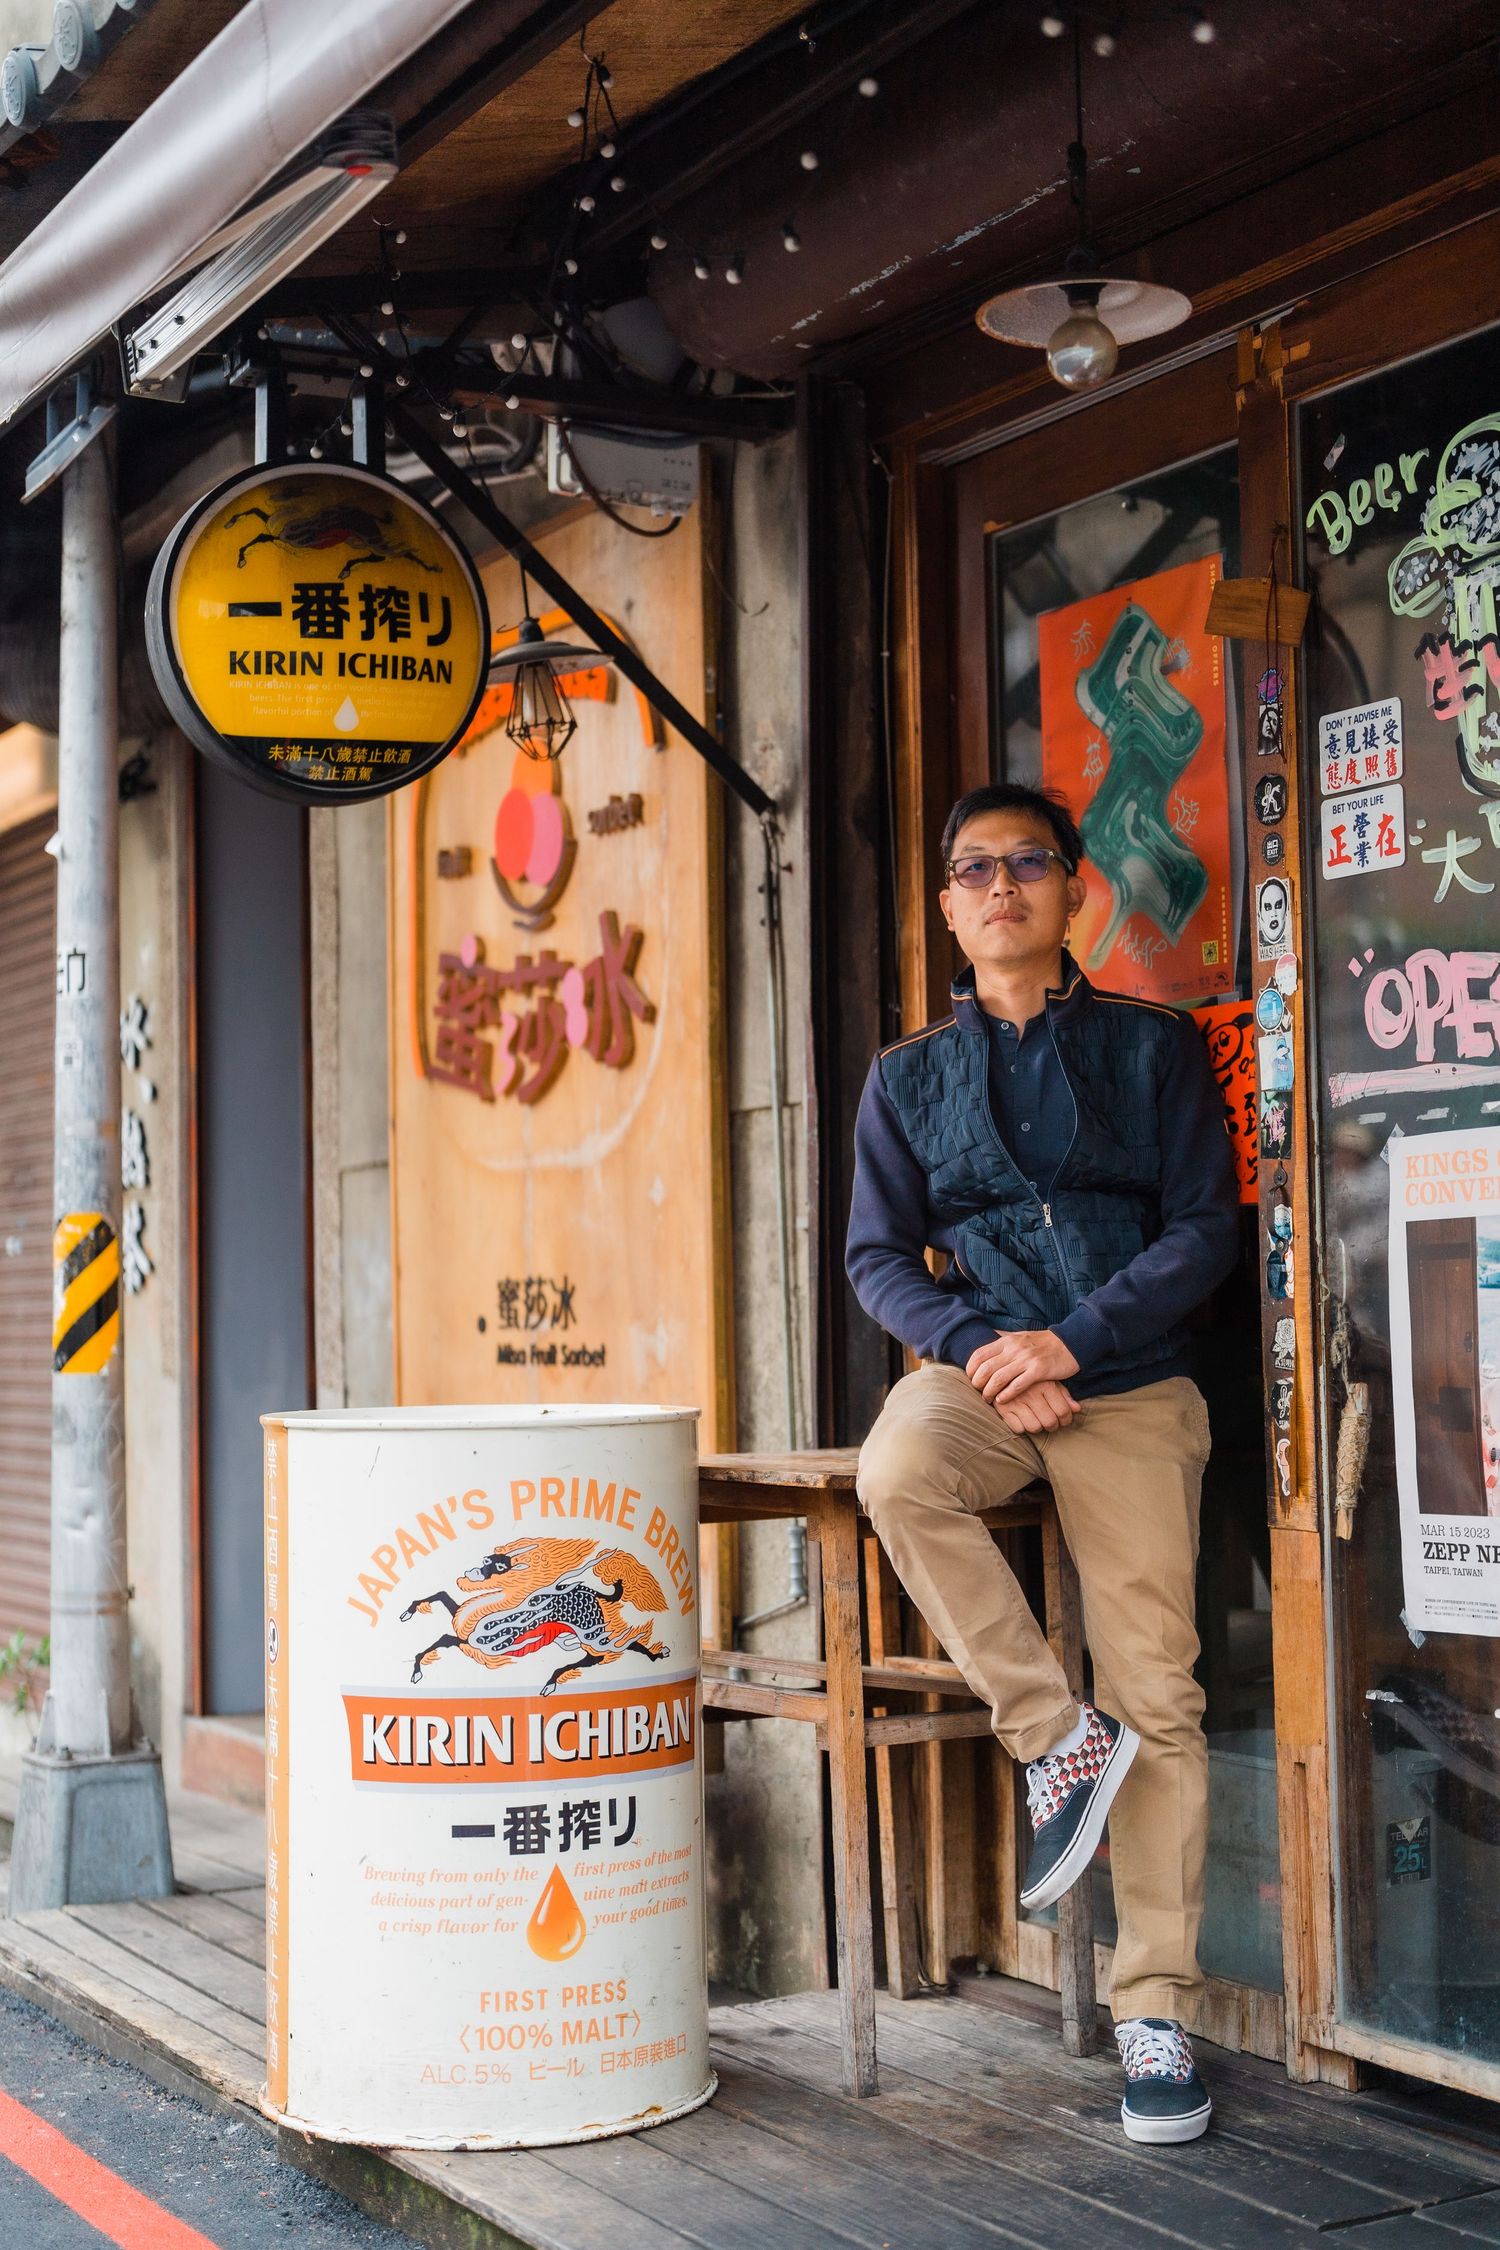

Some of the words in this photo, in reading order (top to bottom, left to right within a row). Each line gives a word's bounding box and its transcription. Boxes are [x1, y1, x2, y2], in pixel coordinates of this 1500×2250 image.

[1306, 448, 1430, 555] Beer
[228, 582, 452, 647] 一番搾り
[229, 651, 323, 677] KIRIN
[338, 652, 453, 685] ICHIBAN
[1354, 709, 1379, 725] ADVISE
[1381, 705, 1393, 717] ME
[268, 744, 412, 765] 未滿十八歲禁止飲酒
[1324, 718, 1400, 760] 意見接受
[308, 765, 374, 782] 禁止酒駕
[1325, 747, 1398, 790] 態度照舊
[1332, 802, 1345, 815] BET
[1347, 799, 1368, 811] YOUR
[1370, 794, 1384, 806] LIFE
[1267, 848, 1279, 856] EXIT
[1406, 1147, 1489, 1179] KINGS
[1420, 1523, 1446, 1537] MAR
[1449, 1526, 1461, 1538] 15
[1463, 1527, 1490, 1539] 2023
[348, 1488, 495, 1628] JAPAN'S
[510, 1477, 641, 1531] PRIME
[643, 1505, 696, 1616] BREW
[1422, 1541, 1471, 1562] ZEPP
[1423, 1565, 1452, 1576] TAIPEI,
[1453, 1567, 1484, 1578] TAIWAN
[362, 1713, 514, 1766] KIRIN
[528, 1696, 692, 1764] ICHIBAN
[451, 1795, 637, 1856] 一番搾り
[364, 1865, 425, 1886] Brewing
[429, 1868, 468, 1884] from
[473, 1868, 509, 1886] only
[513, 1866, 539, 1881] the
[573, 1861, 604, 1877] first
[608, 1858, 642, 1877] press
[644, 1851, 657, 1867] of
[657, 1850, 672, 1865] the
[674, 1844, 692, 1860] most
[371, 1892, 436, 1909] delicious
[439, 1894, 473, 1912] part
[477, 1893, 495, 1908] of
[496, 1895, 528, 1911] gen-
[584, 1886, 615, 1901] uine
[619, 1879, 648, 1897] malt
[651, 1870, 690, 1890] extracts
[378, 1920, 388, 1932] a
[393, 1919, 432, 1936] crisp
[437, 1918, 490, 1934] flavor
[493, 1918, 519, 1933] for
[592, 1910, 627, 1929] your
[630, 1900, 660, 1924] good
[480, 1988, 549, 2014] FIRST
[561, 1978, 628, 2009] PRESS
